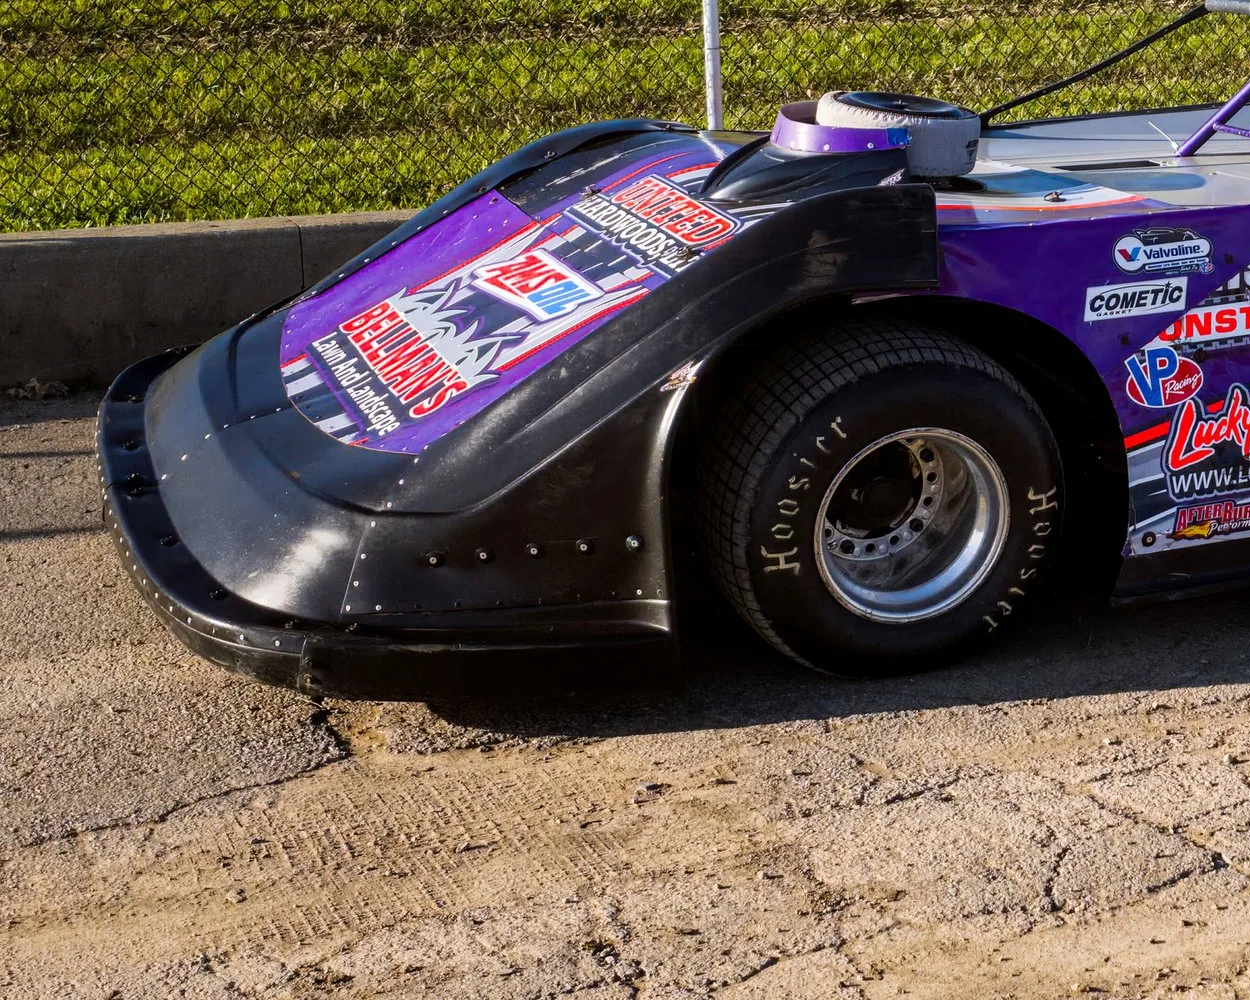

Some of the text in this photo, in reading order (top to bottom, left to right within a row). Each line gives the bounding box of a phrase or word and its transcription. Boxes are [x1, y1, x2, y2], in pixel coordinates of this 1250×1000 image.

[611, 178, 735, 244] UNITED
[1143, 244, 1200, 260] Valvoline
[484, 254, 592, 315] AMSOIL
[1089, 286, 1183, 313] COMETIC
[1096, 309, 1132, 317] GASKET
[312, 332, 401, 436] Lawn And Landscape
[339, 300, 470, 418] BELLMAN'S
[1125, 347, 1179, 407] VP
[1165, 372, 1202, 400] Racing
